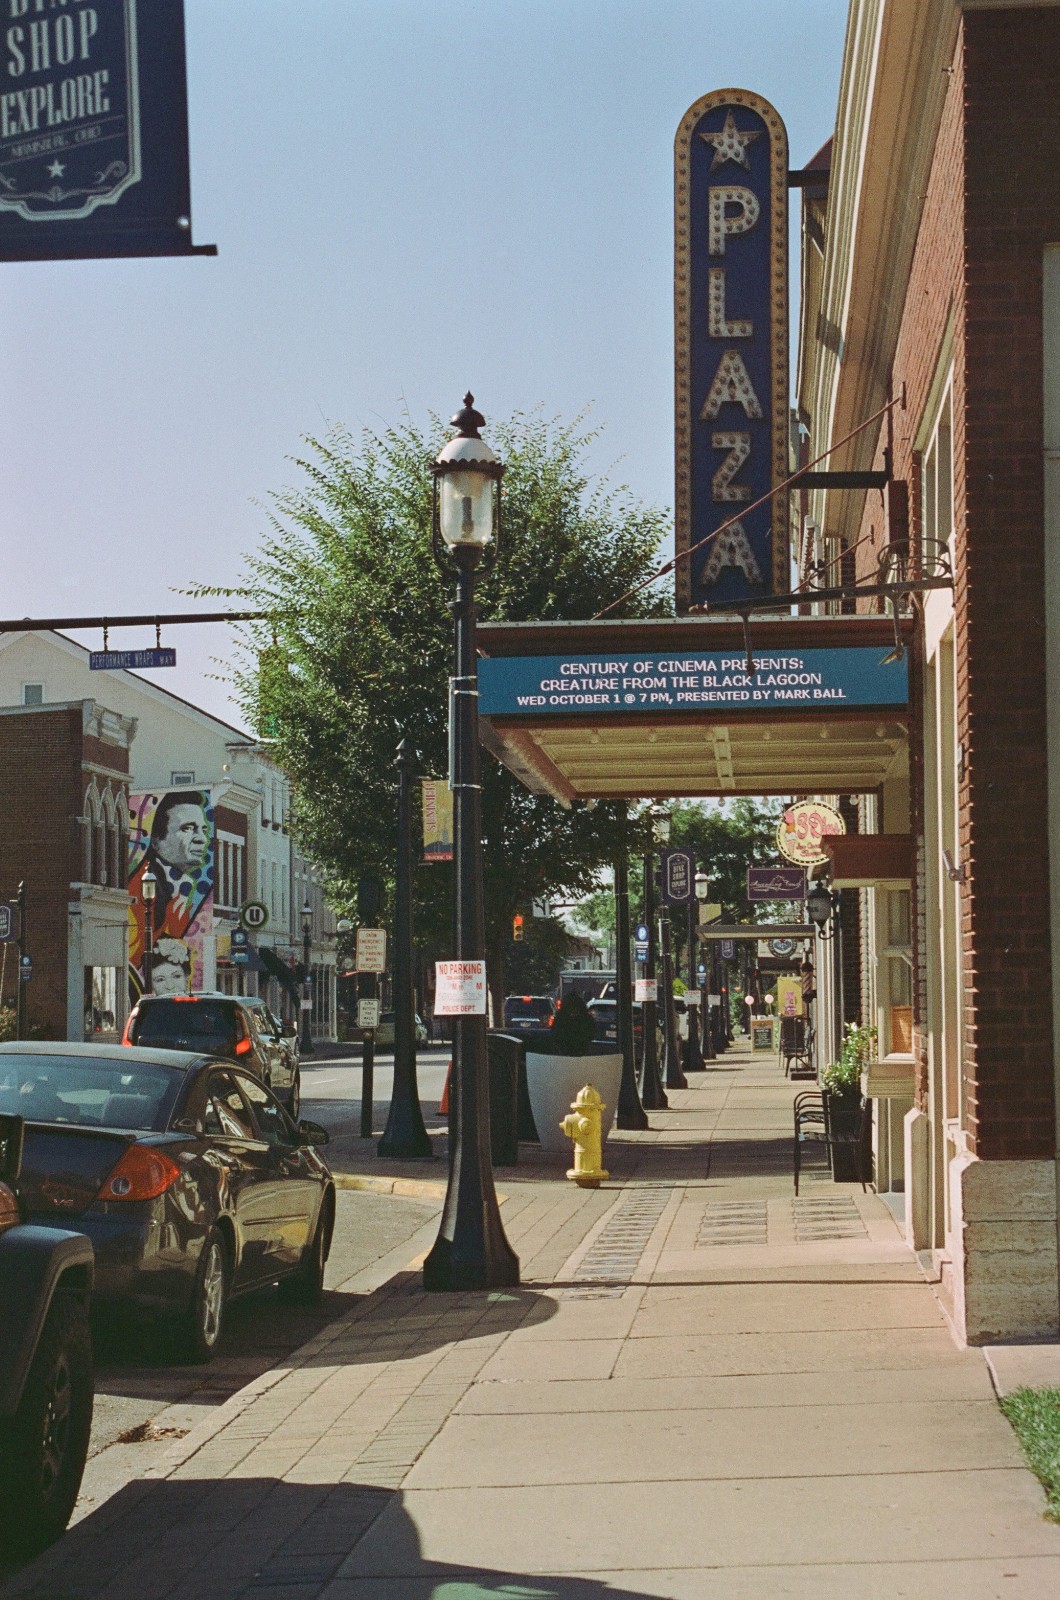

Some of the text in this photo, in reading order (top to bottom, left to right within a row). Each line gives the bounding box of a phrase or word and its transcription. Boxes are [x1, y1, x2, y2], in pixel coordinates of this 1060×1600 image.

[6, 8, 98, 77] SHOP
[0, 69, 110, 138] EXPLORE
[701, 185, 764, 585] PLAZA
[91, 651, 173, 669] PERFORMANCE WRAPS WAY
[560, 662, 629, 675] CENTURY
[633, 661, 653, 673] OF
[657, 660, 717, 673] CINEMA
[540, 673, 822, 691] CREATURE FROM THE BLACK LAGOON
[517, 688, 847, 705] WED OCTOBER 1 @ 7 PM, PRESENTED BY MARK BALL
[438, 963, 482, 975] NO PARKING
